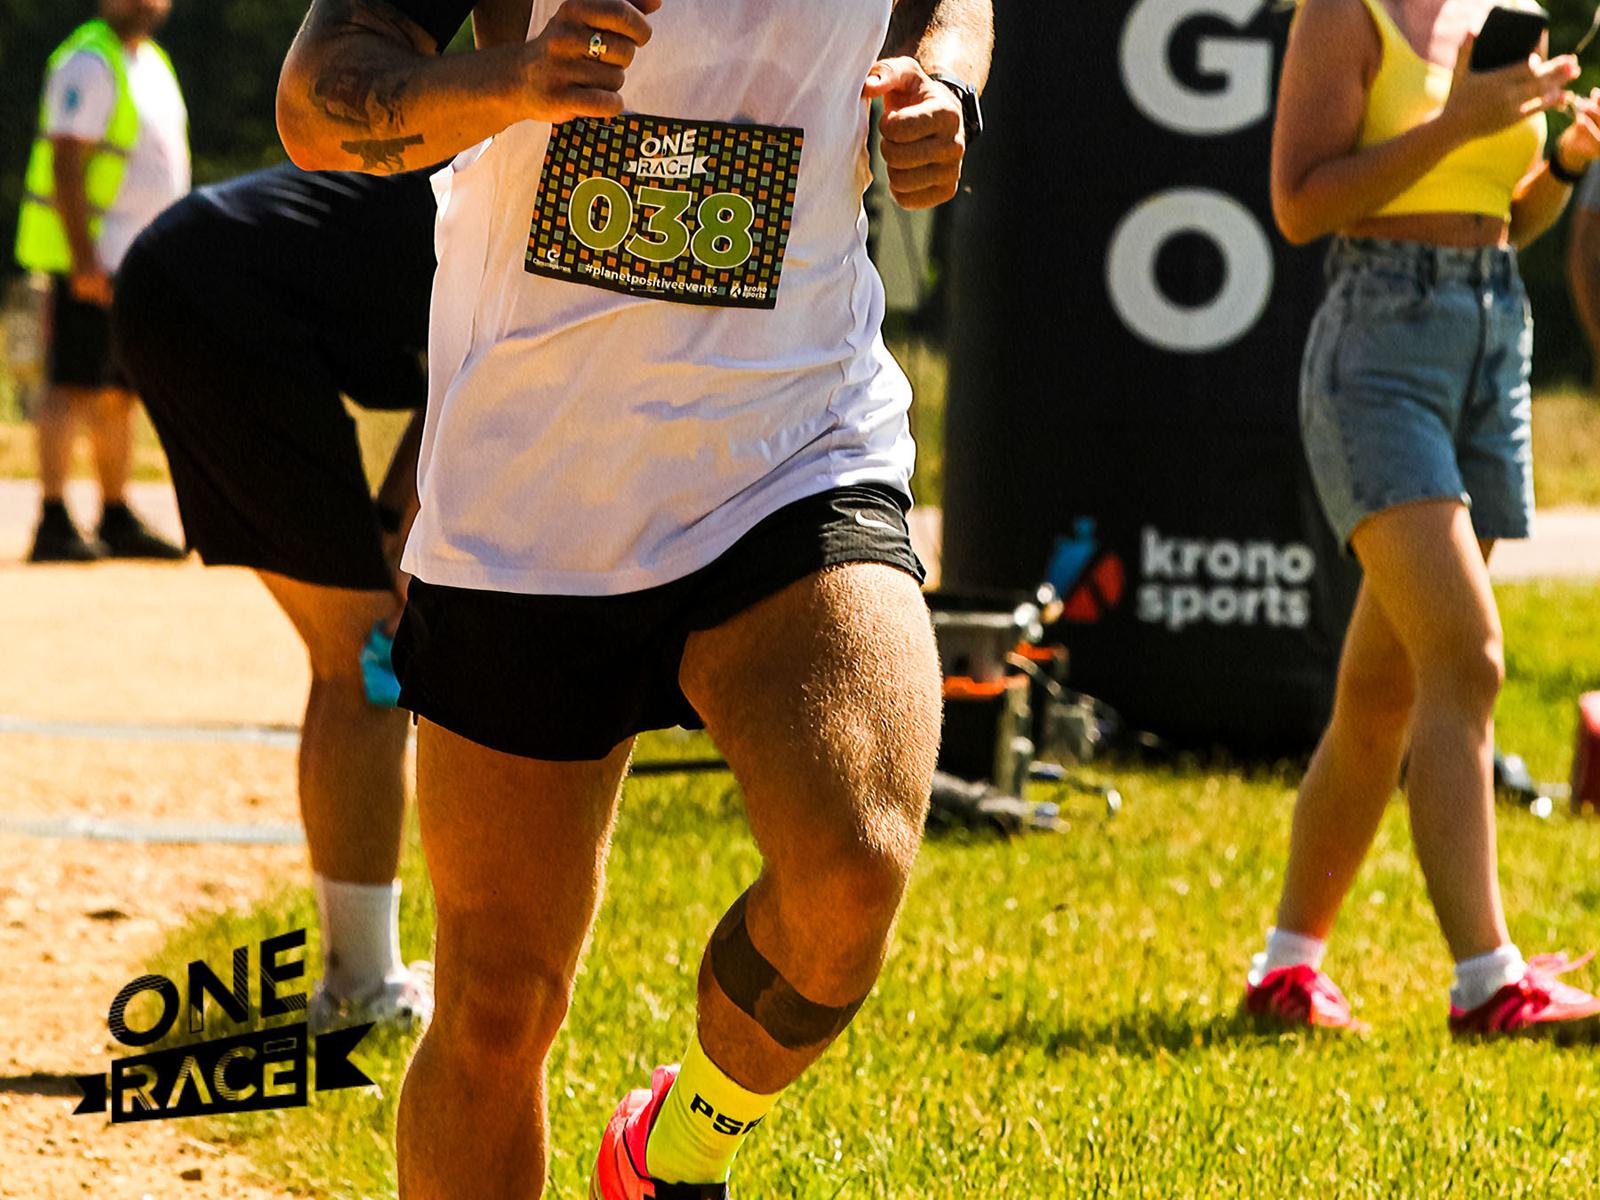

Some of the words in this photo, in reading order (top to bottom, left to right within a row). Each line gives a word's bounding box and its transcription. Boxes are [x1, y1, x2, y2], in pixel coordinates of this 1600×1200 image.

[640, 129, 697, 157] ONE
[639, 158, 690, 176] RACE
[568, 176, 755, 269] 038
[584, 263, 718, 295] #planetpositiveevents
[1140, 526, 1314, 584] krono
[1137, 583, 1310, 632] sports
